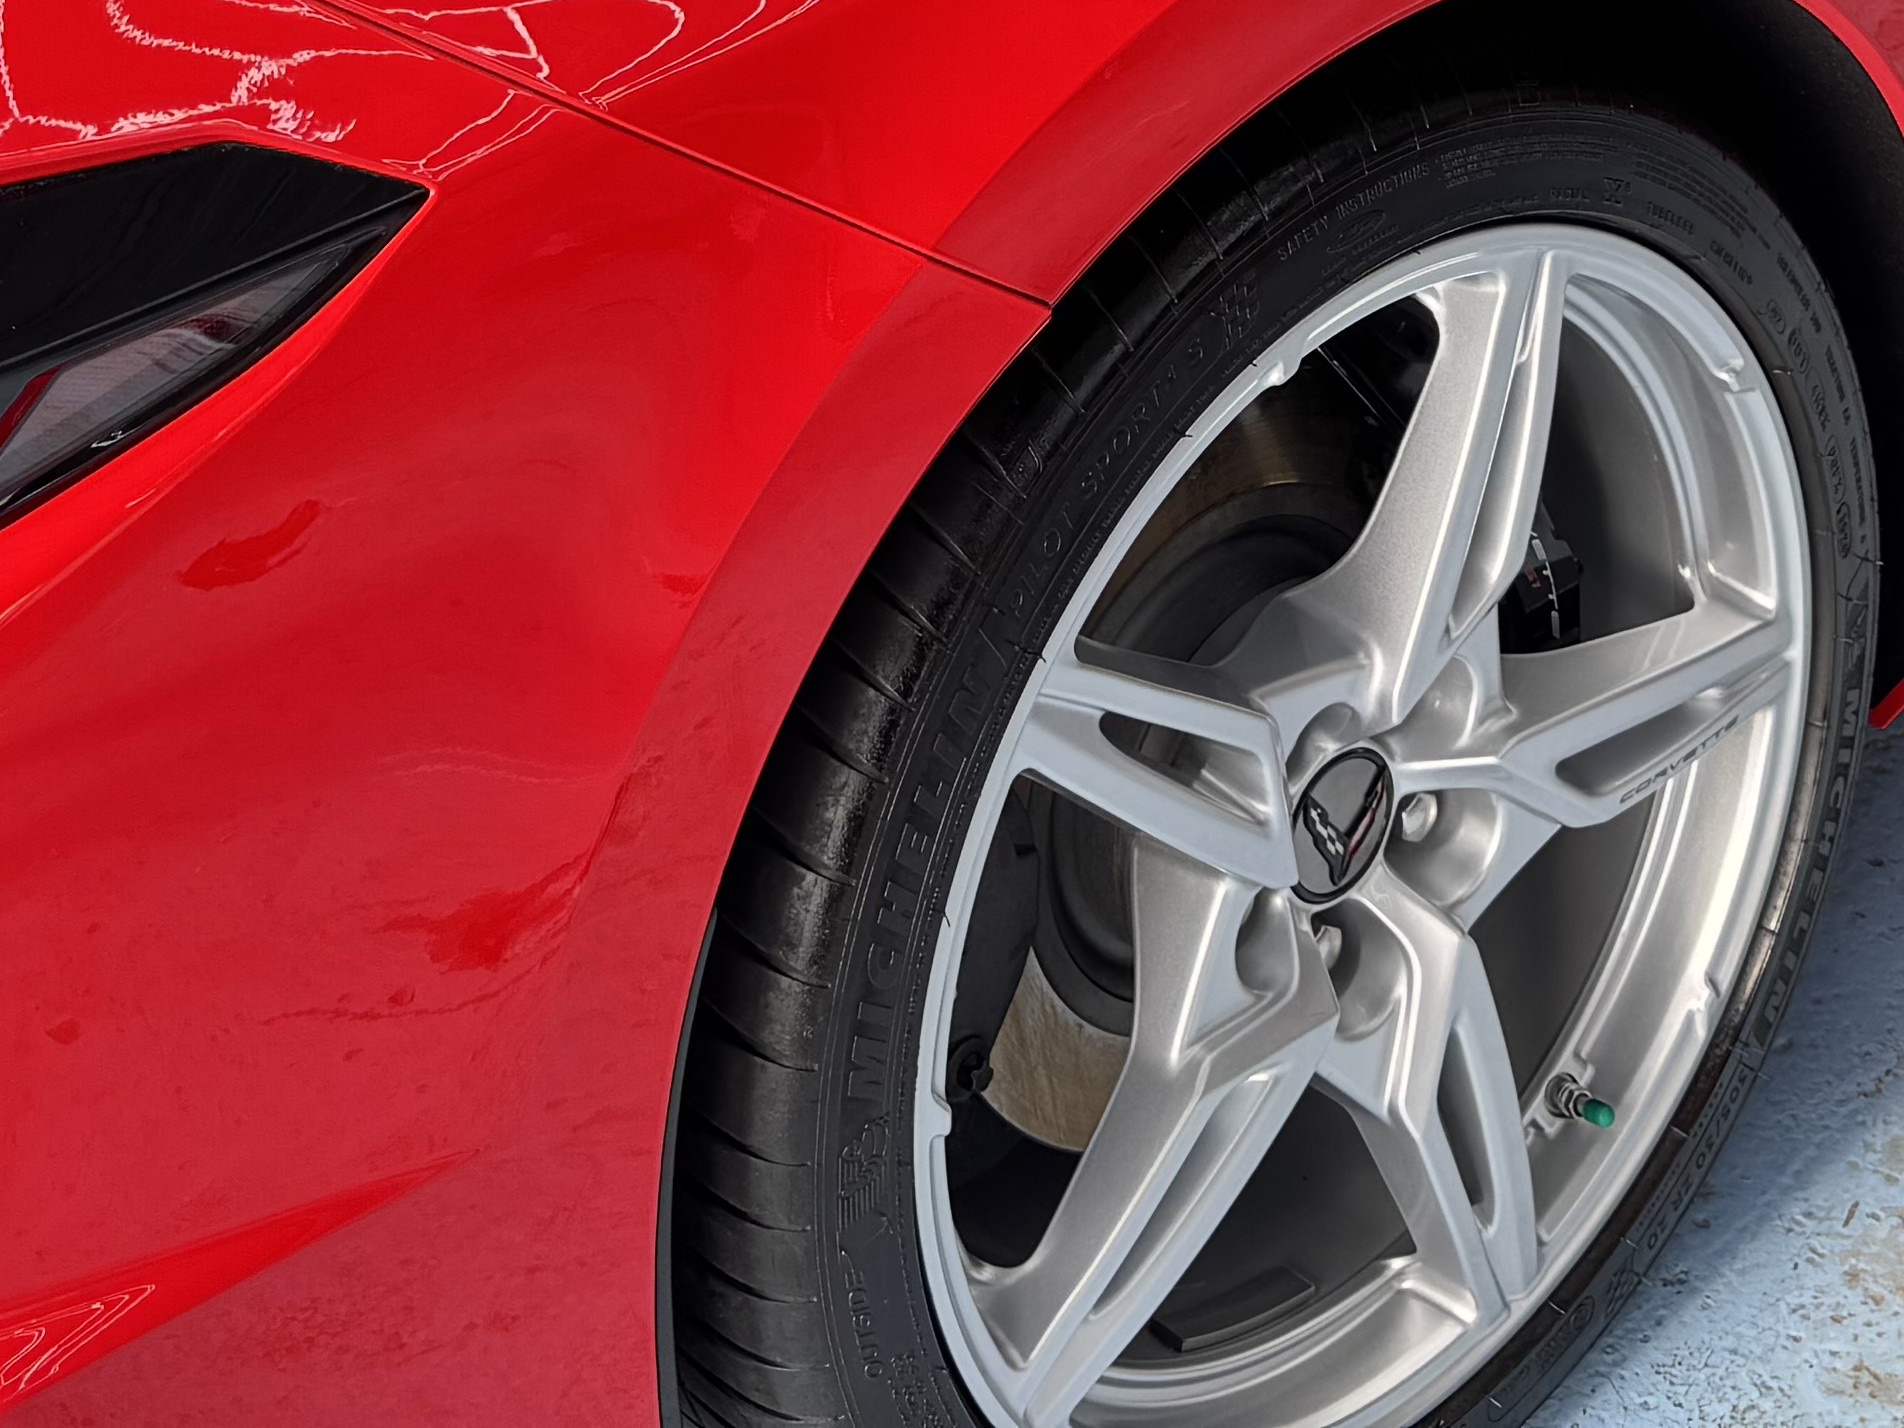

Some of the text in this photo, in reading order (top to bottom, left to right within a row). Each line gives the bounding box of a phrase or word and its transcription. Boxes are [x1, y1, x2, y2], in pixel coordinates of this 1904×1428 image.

[1277, 215, 1328, 260] SAFETY
[1336, 162, 1429, 220] INSTRUCTIONS
[1079, 378, 1161, 500] SPORT
[1618, 714, 1740, 804] CORVETTE
[847, 666, 991, 1100] MICHELIN
[1764, 687, 1861, 1022] MICHELIN
[1647, 1215, 1669, 1251] 20
